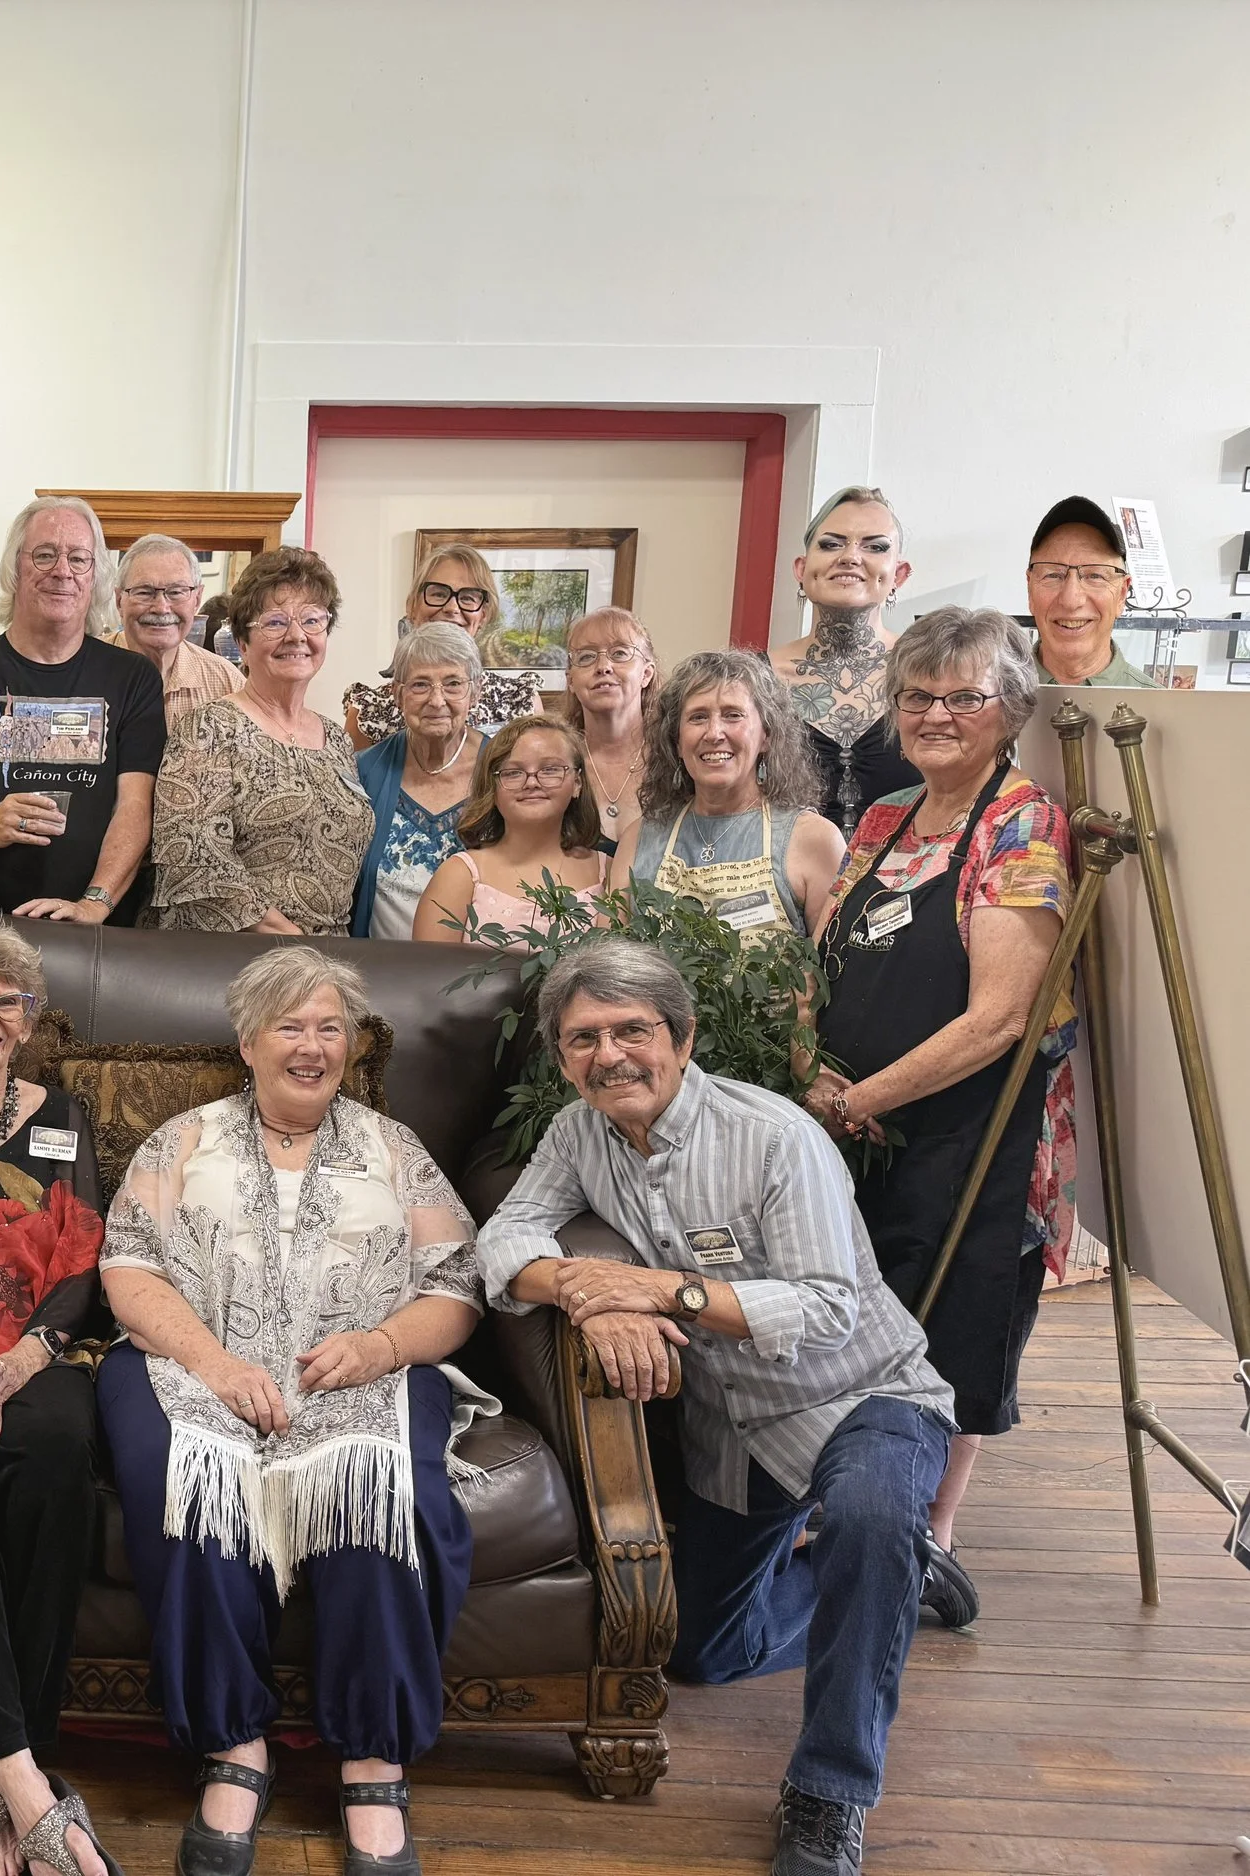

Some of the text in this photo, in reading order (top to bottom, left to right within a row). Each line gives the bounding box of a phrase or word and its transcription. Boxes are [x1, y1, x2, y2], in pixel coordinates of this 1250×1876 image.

[13, 767, 97, 788] Cañon City
[720, 863, 739, 871] loved.
